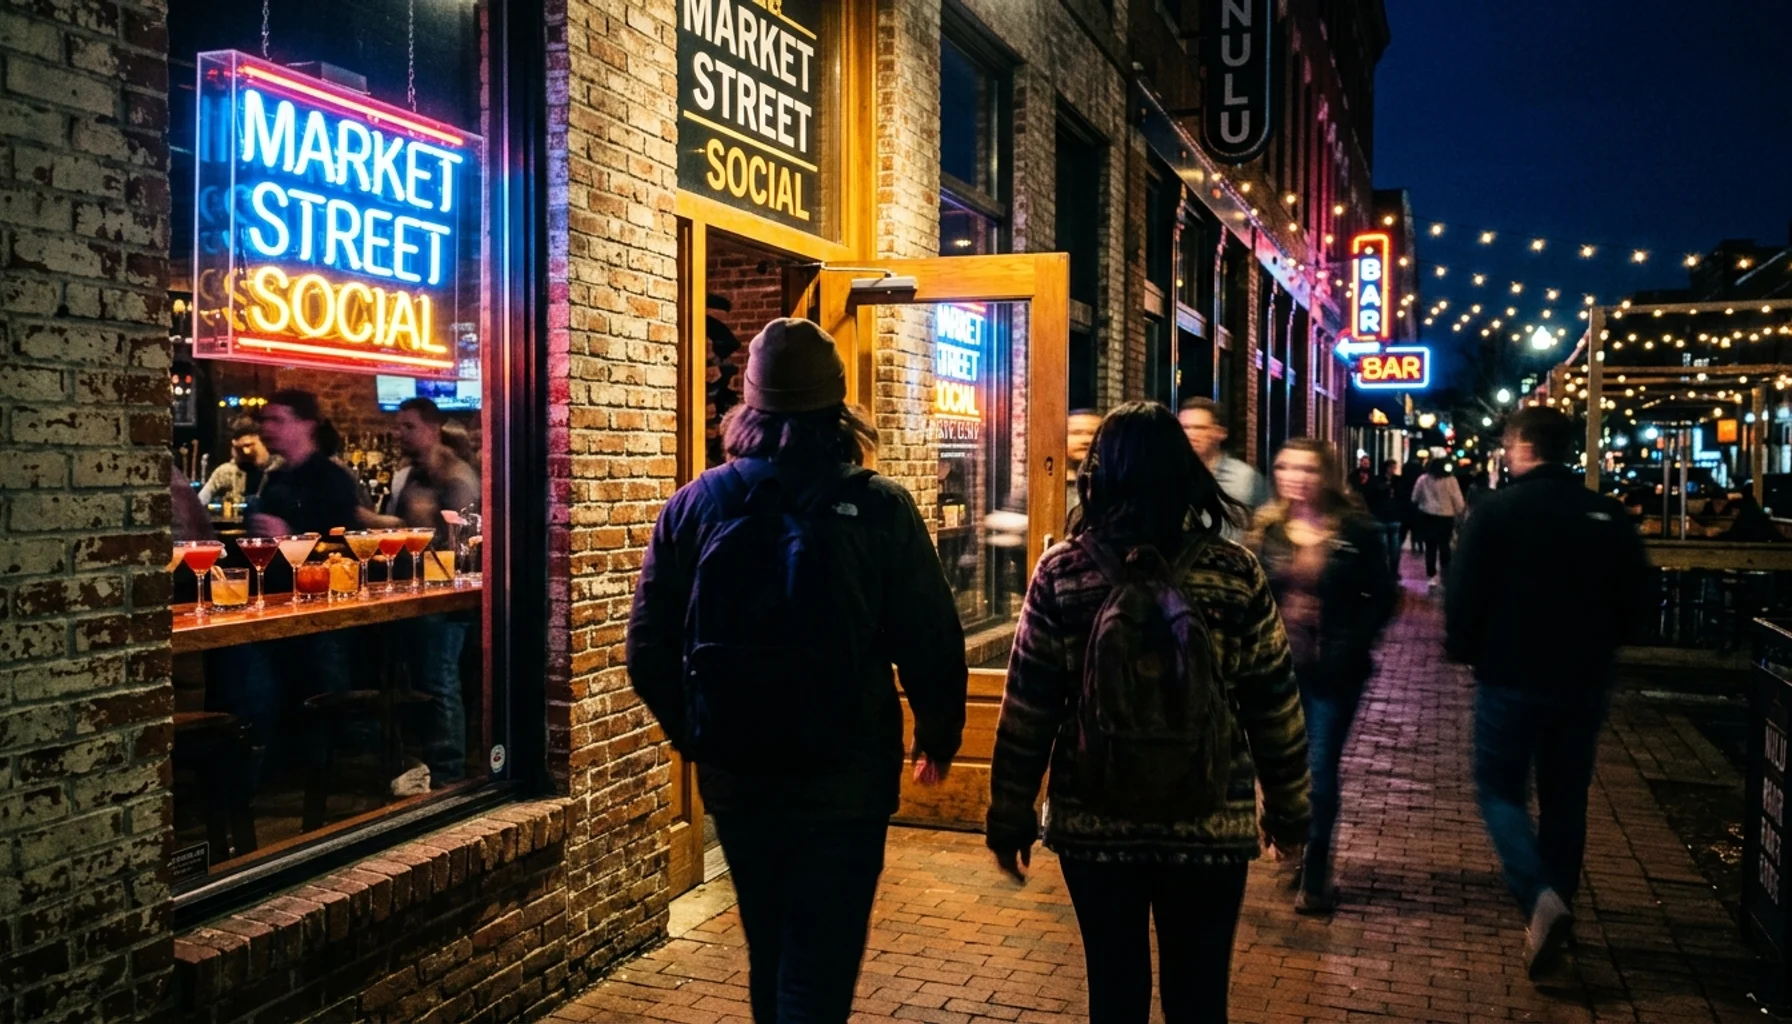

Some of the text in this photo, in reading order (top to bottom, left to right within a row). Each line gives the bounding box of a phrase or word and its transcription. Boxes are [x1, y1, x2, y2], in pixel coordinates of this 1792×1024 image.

[684, 0, 814, 93] MARKET
[1220, 0, 1252, 144] NULU
[693, 51, 812, 153] STREET
[242, 88, 463, 213] MARKET
[706, 138, 810, 221] SOCIAL
[249, 181, 451, 285] STREET
[251, 266, 448, 354] SOCIAL
[1360, 258, 1381, 332] BAR
[1361, 355, 1421, 380] BAR
